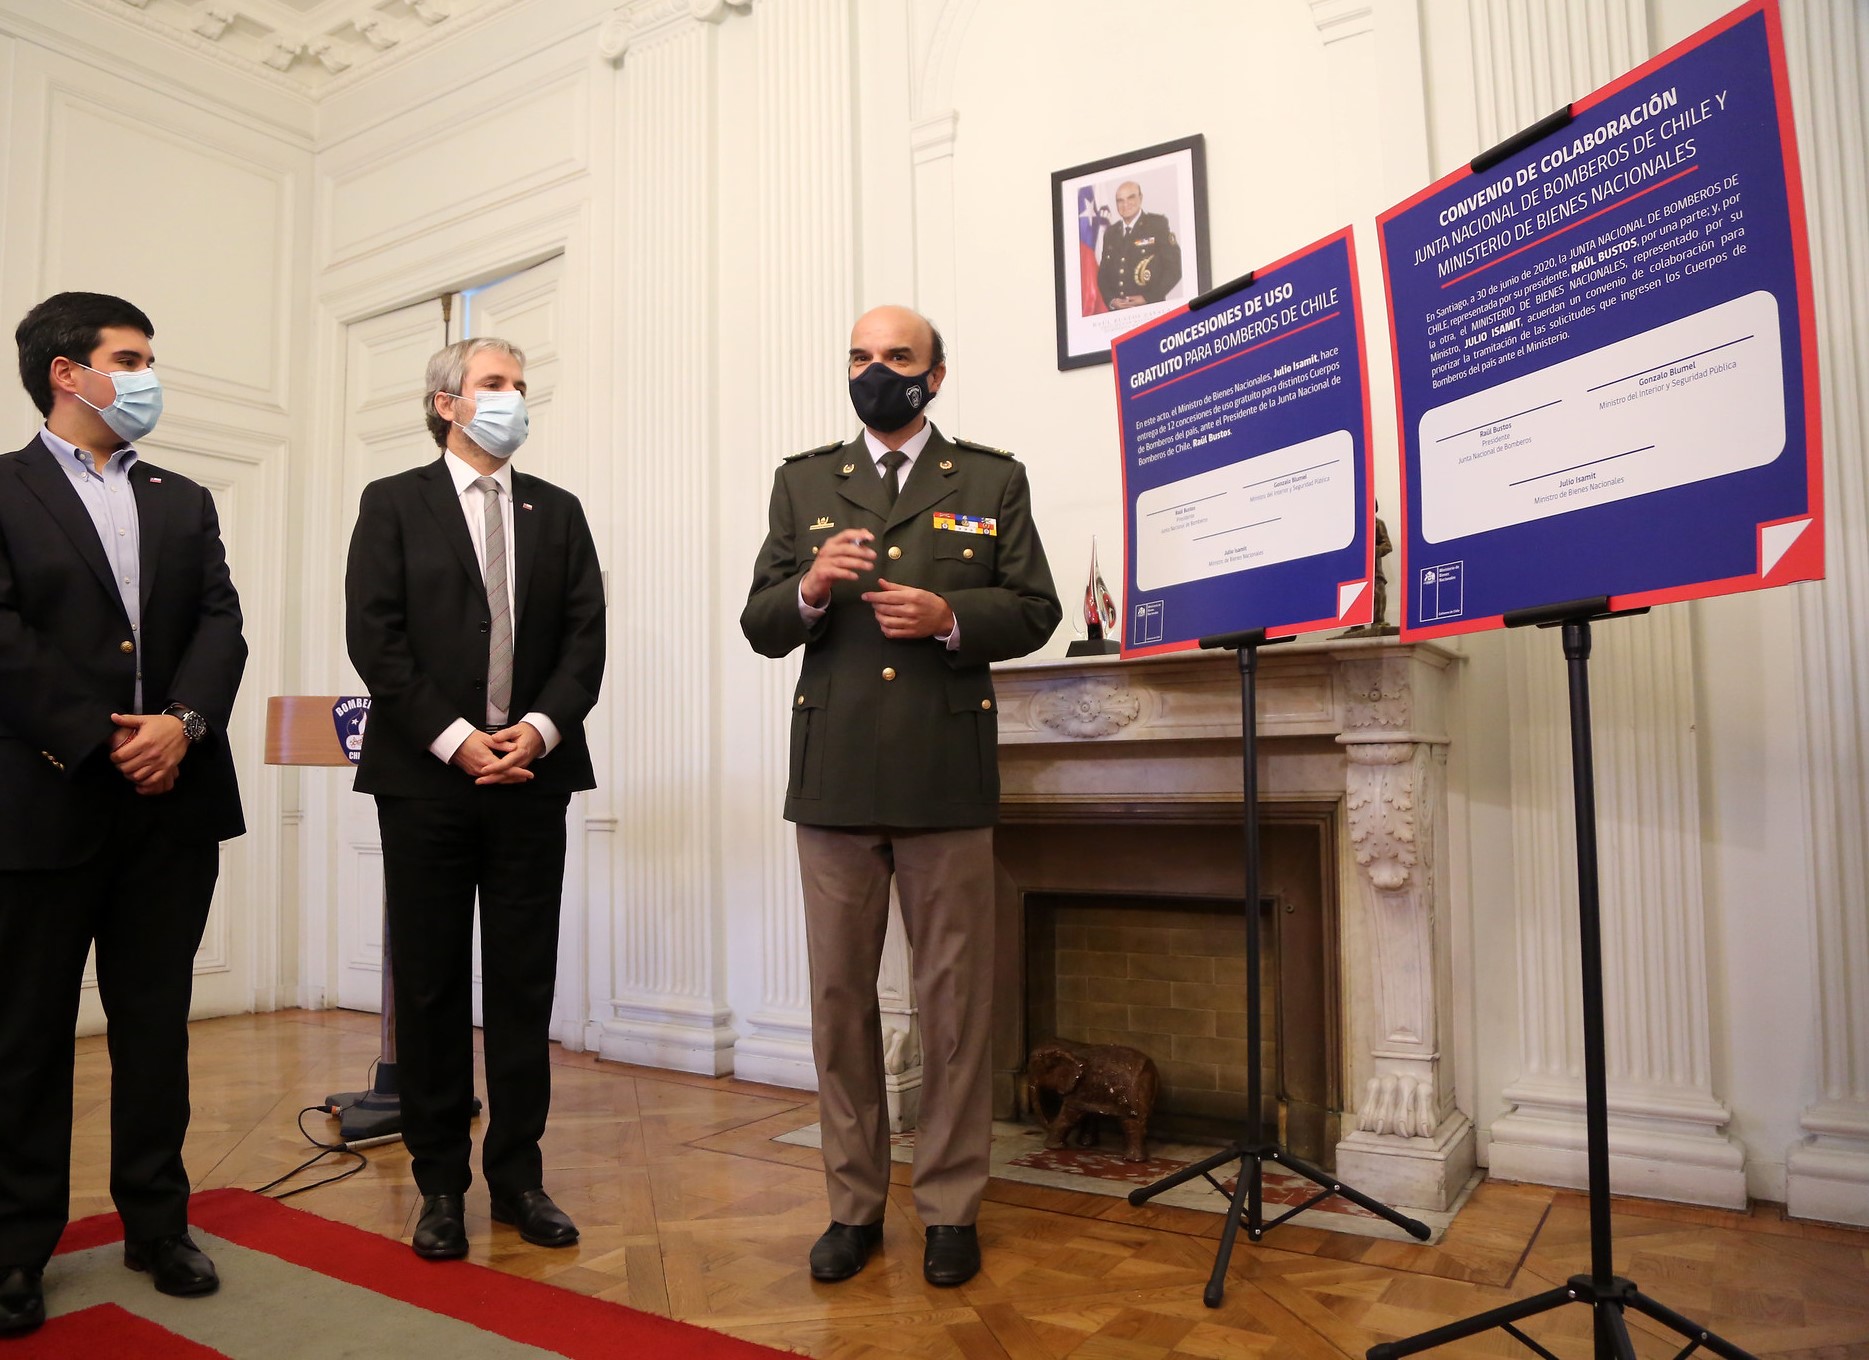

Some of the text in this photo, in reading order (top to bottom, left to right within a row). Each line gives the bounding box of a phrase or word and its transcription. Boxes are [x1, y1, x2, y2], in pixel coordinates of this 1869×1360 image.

[1414, 90, 1726, 266] JUNTA NACIONAL DE BOMBEROS DE CHILE Y
[1439, 87, 1677, 226] CONVENIO DE COLABORACIÓN
[1426, 313, 1435, 323] En
[1476, 288, 1486, 300] 30
[1488, 284, 1498, 295] de
[1499, 275, 1519, 292] junio
[1521, 269, 1531, 280] de
[1558, 254, 1567, 264] la
[1569, 239, 1596, 259] JUNTA
[1597, 217, 1645, 246] NACIONAL
[1647, 209, 1661, 224] DE
[1663, 181, 1721, 217] BOMBEROS
[1723, 173, 1739, 189] DE
[1438, 138, 1696, 278] MINISTERIO DE BIENES NACIONALES
[1450, 299, 1498, 326] representada
[1498, 293, 1512, 307] por
[1513, 289, 1523, 299] su
[1570, 255, 1597, 274] RAÚL
[1641, 229, 1657, 246] por
[1659, 221, 1678, 235] una
[1722, 192, 1740, 210] por
[1464, 331, 1487, 349] JULIO
[1527, 301, 1565, 323] acuerdan
[1569, 295, 1581, 305] un
[1585, 276, 1626, 299] convenio
[1631, 269, 1644, 280] de
[1649, 240, 1714, 273] colaboración
[1720, 227, 1744, 246] para
[1471, 305, 1515, 331] MINISTERIO
[1519, 298, 1531, 311] DE
[1535, 284, 1564, 304] BIENES
[1633, 229, 1698, 263] representado
[1705, 218, 1723, 235] por
[1730, 210, 1743, 222] su
[1130, 287, 1338, 388] GRATUITO PARA BOMBEROS DE CHILE
[1159, 305, 1242, 353] CONCESIONES
[1244, 295, 1262, 316] DE
[1264, 282, 1293, 307] USO
[1431, 358, 1460, 378] priorizar
[1473, 335, 1517, 359] tramitación
[1520, 330, 1531, 340] de
[1533, 324, 1546, 335] las
[1549, 304, 1596, 329] solicitudes
[1599, 296, 1616, 311] que
[1620, 279, 1661, 301] ingresen
[1665, 270, 1680, 283] los
[1684, 252, 1727, 275] Cuerpos
[1732, 244, 1746, 256] de
[1136, 428, 1158, 442] entrega
[1175, 408, 1212, 428] concesiones
[1212, 404, 1221, 414] de
[1221, 400, 1234, 411] uso
[1234, 390, 1261, 408] gratuito
[1261, 384, 1277, 398] para
[1277, 372, 1309, 390] distintos
[1309, 361, 1340, 379] Cuerpos
[1143, 416, 1156, 427] este
[1177, 399, 1203, 413] Ministro
[1203, 394, 1212, 404] de
[1212, 387, 1234, 401] Bienes
[1273, 364, 1292, 378] Julio
[1320, 347, 1338, 360] hace
[1432, 369, 1467, 389] Bomberos
[1468, 363, 1480, 375] del
[1481, 357, 1497, 373] país
[1498, 351, 1515, 364] ante
[1516, 345, 1525, 357] el
[1599, 396, 1626, 410] Ministro
[1627, 391, 1638, 401] del
[1639, 384, 1664, 397] Interior
[1671, 368, 1708, 387] Seguridad
[1709, 361, 1737, 375] Pública
[1638, 361, 1696, 386] Gonzalo Blumel
[1138, 450, 1166, 466] Bomberos
[1192, 434, 1207, 447] Raúl
[1145, 435, 1174, 451] Bomberos
[1174, 429, 1184, 441] del
[1200, 421, 1214, 432] ante
[1222, 405, 1257, 424] Presidente
[1258, 401, 1268, 411] de
[1277, 391, 1297, 405] Junta
[1297, 377, 1330, 397] Nacional
[1331, 375, 1341, 386] de
[1479, 422, 1512, 438] Raúl Bustos
[1559, 472, 1596, 488] Julio Isamit
[348, 751, 361, 760] CHI
